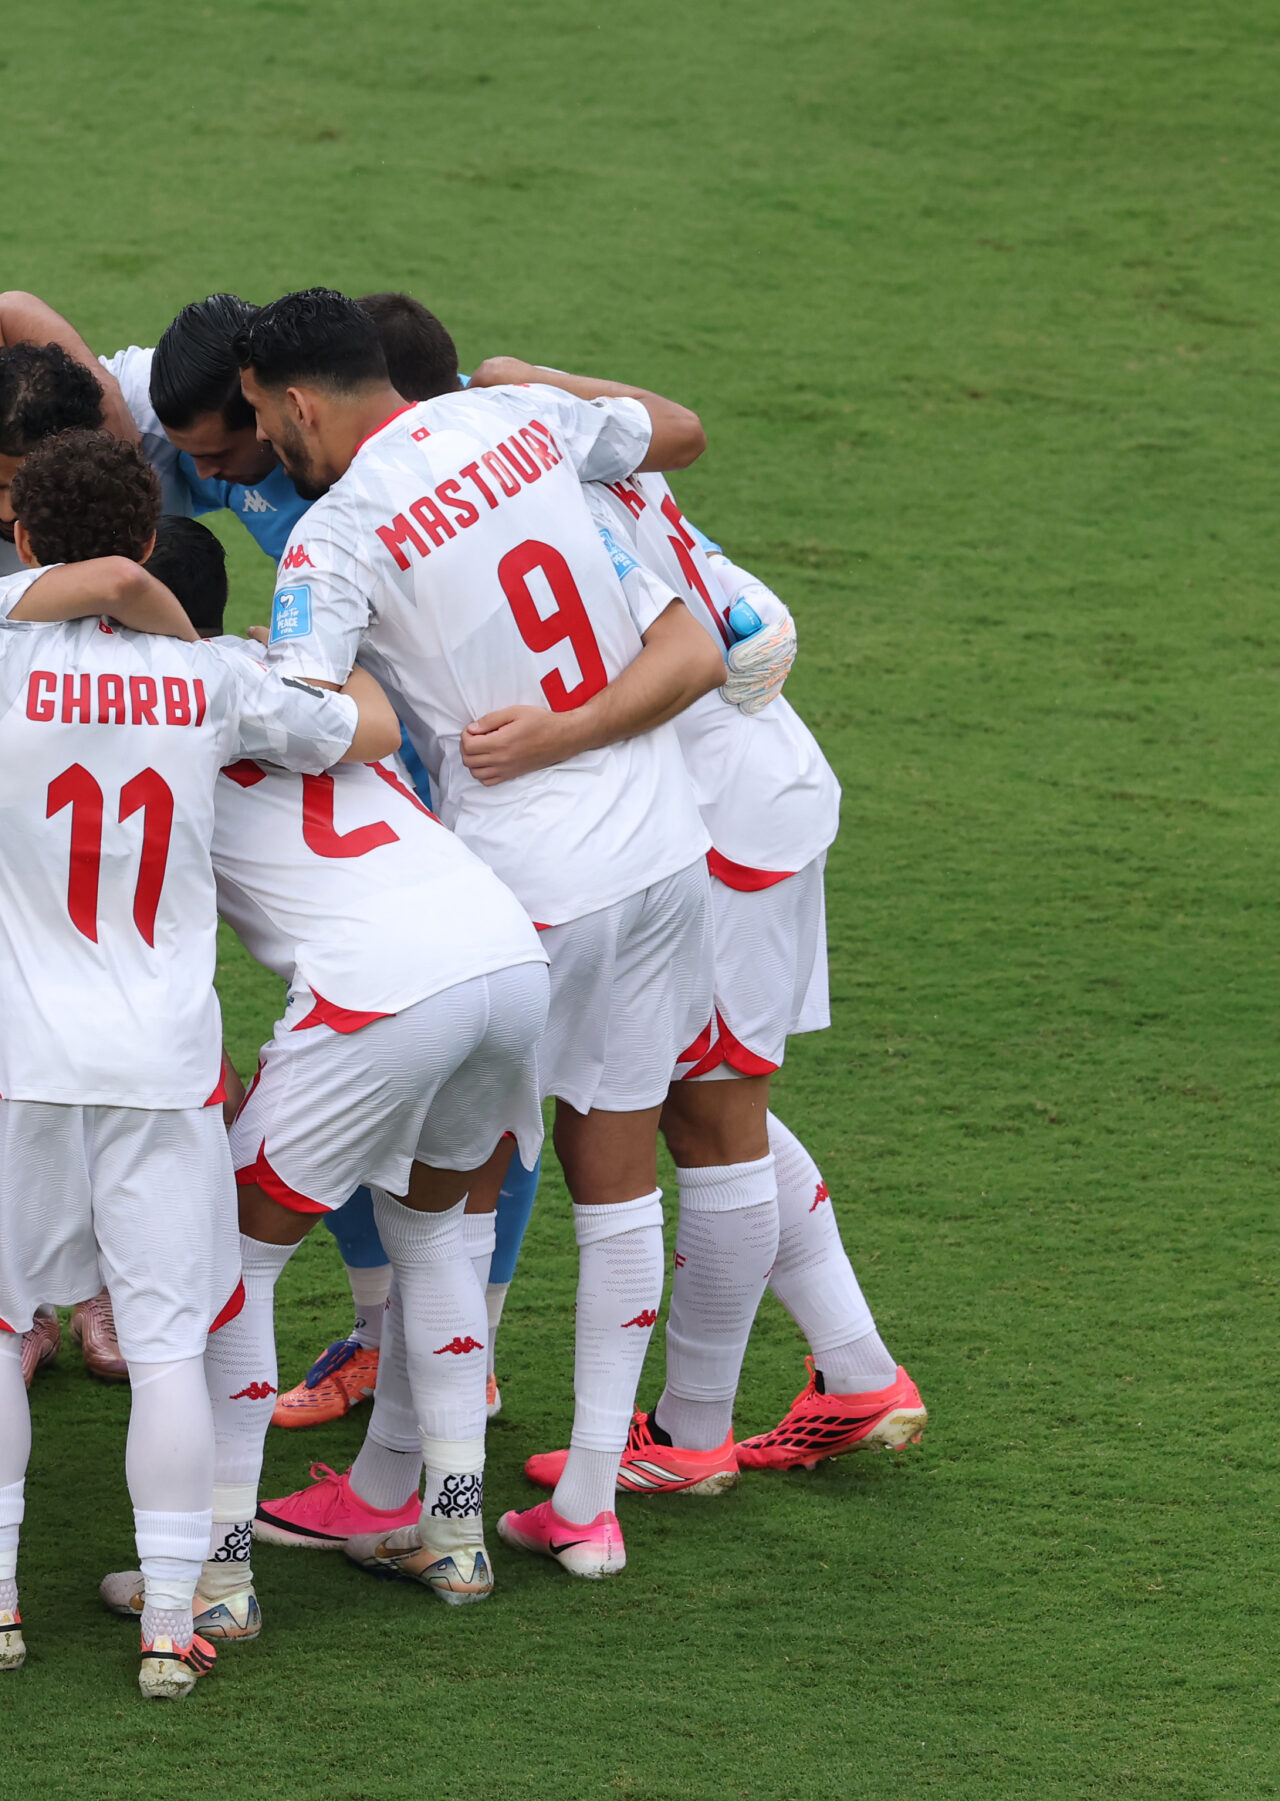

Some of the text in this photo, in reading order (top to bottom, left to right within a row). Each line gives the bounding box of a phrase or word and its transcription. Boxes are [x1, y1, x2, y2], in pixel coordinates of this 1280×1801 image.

[277, 616, 299, 631] PEACE
[497, 539, 609, 713] 9
[25, 670, 207, 728] GHARBI
[46, 762, 175, 949] 11
